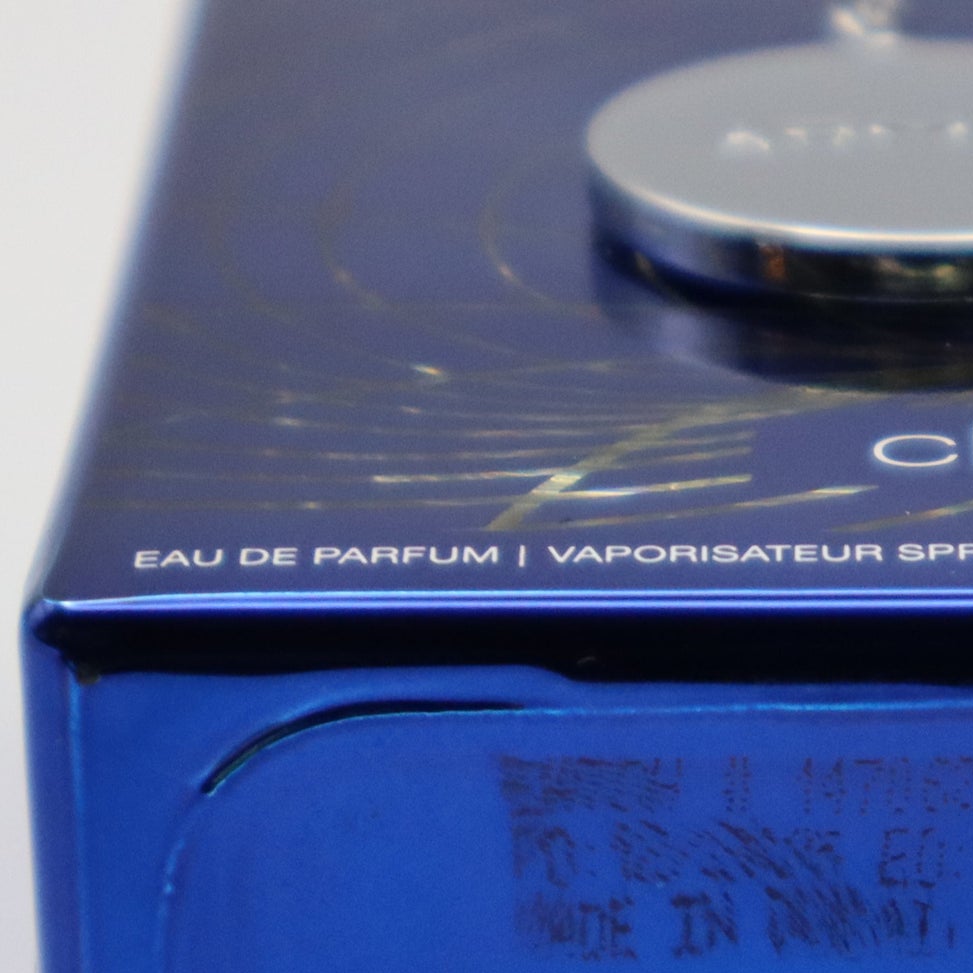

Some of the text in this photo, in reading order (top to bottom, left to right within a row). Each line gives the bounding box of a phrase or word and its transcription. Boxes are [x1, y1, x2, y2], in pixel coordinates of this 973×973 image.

[134, 549, 223, 568] EAU
[239, 547, 298, 566] DE
[313, 545, 499, 565] PARFUM
[547, 544, 883, 564] VAPORISATEUR
